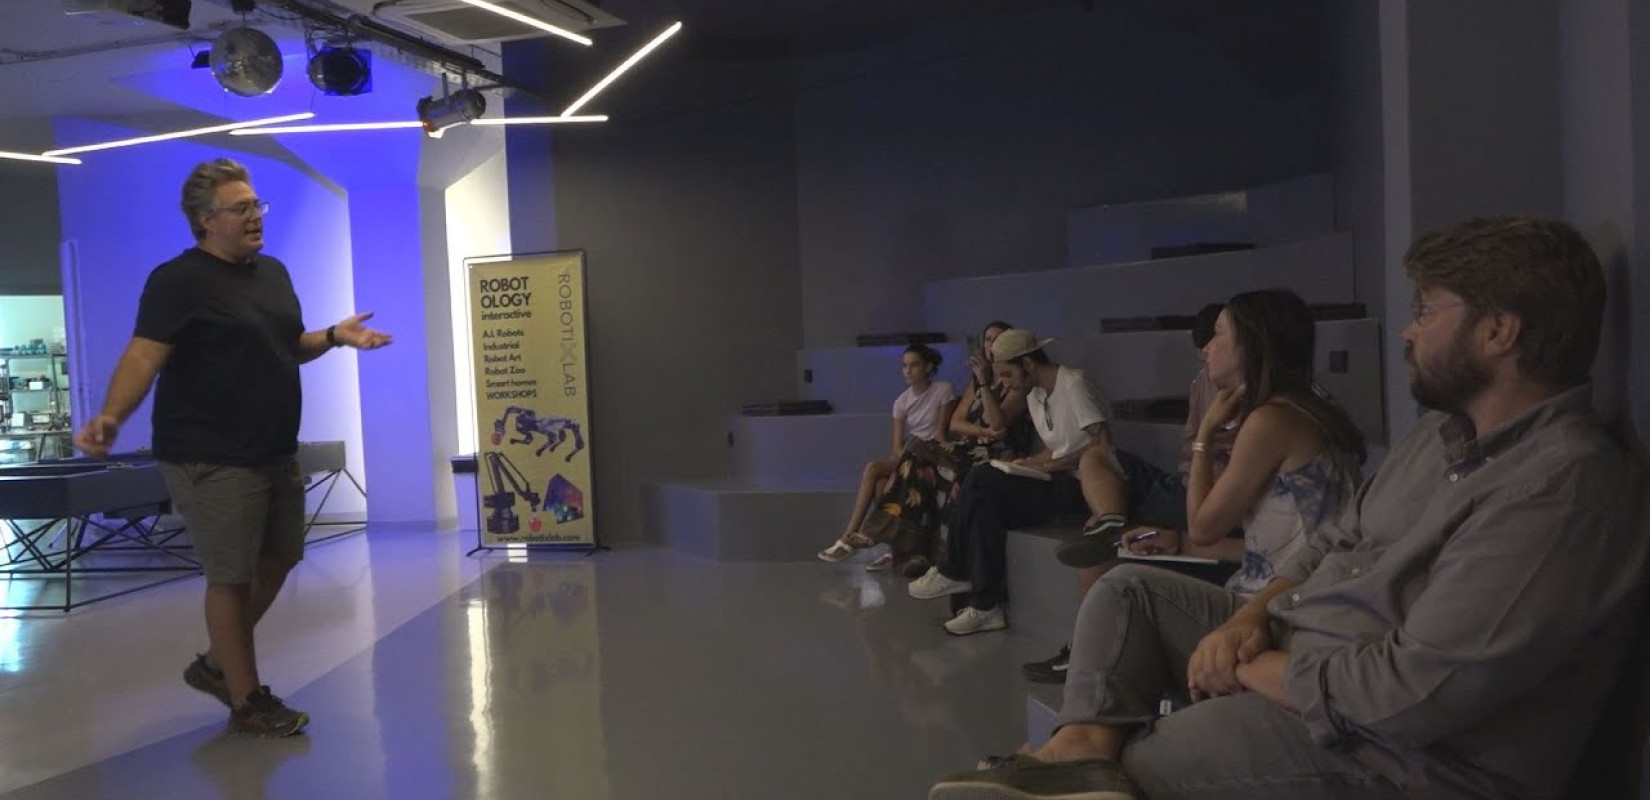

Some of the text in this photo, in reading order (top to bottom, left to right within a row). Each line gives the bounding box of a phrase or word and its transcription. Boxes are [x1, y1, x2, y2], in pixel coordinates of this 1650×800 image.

[480, 276, 529, 293] ROBOT
[480, 293, 532, 308] OLOGY
[481, 309, 532, 321] interactive
[497, 328, 525, 338] Robots
[483, 341, 520, 351] Industrial
[484, 354, 522, 363] Robot Art
[485, 366, 526, 375] Robot Zoo
[486, 380, 511, 388] Smart
[486, 390, 537, 400] WORKSHOPS
